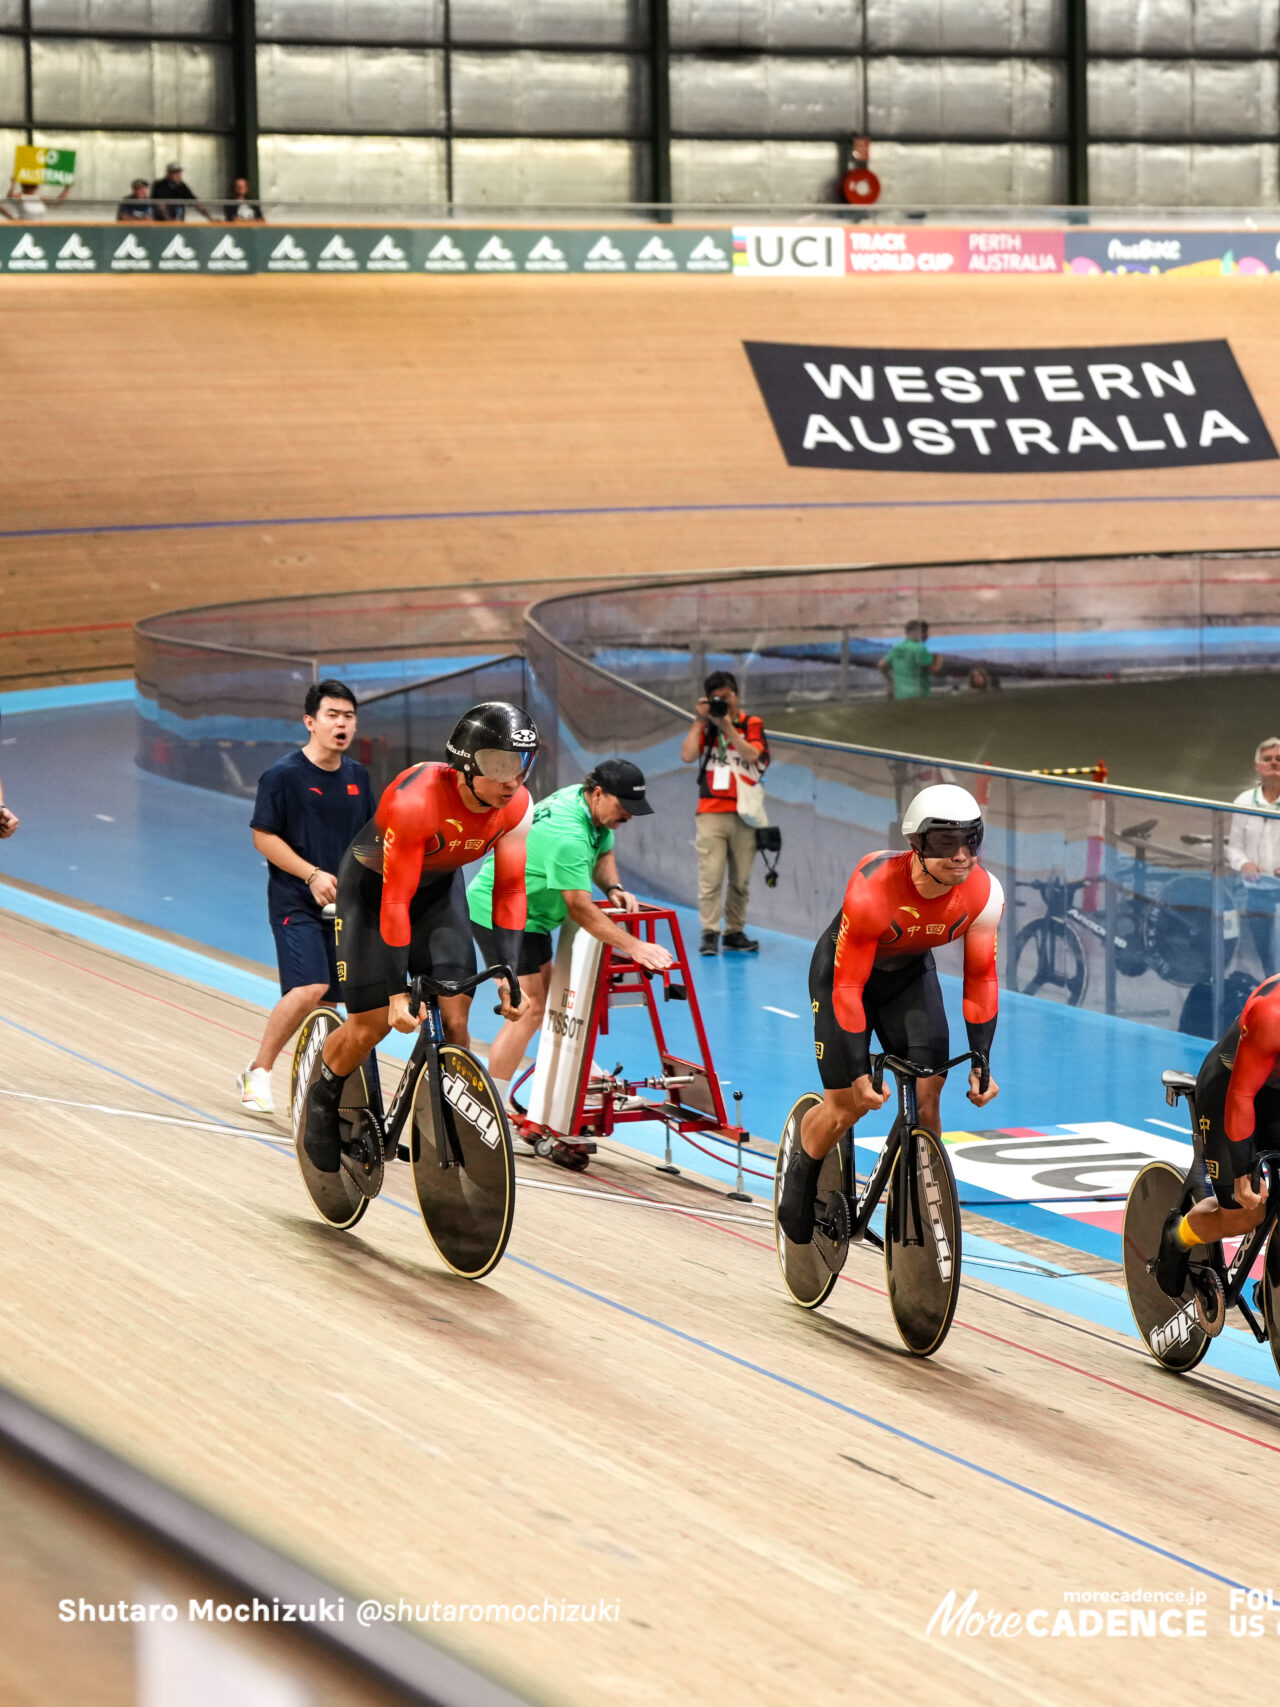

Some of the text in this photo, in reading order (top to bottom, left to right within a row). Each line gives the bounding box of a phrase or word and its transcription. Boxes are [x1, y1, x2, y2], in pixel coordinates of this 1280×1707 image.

[754, 235, 832, 268] UCI
[850, 233, 906, 251] TRACK
[968, 233, 1021, 251] PERTH
[850, 253, 954, 271] WORLD CUP
[968, 253, 1057, 272] AUSTRALIA
[803, 360, 1196, 403] WESTERN
[803, 409, 1249, 456] AUSTRALIA
[547, 1009, 584, 1041] TISSOT
[954, 1137, 1189, 1193] UC
